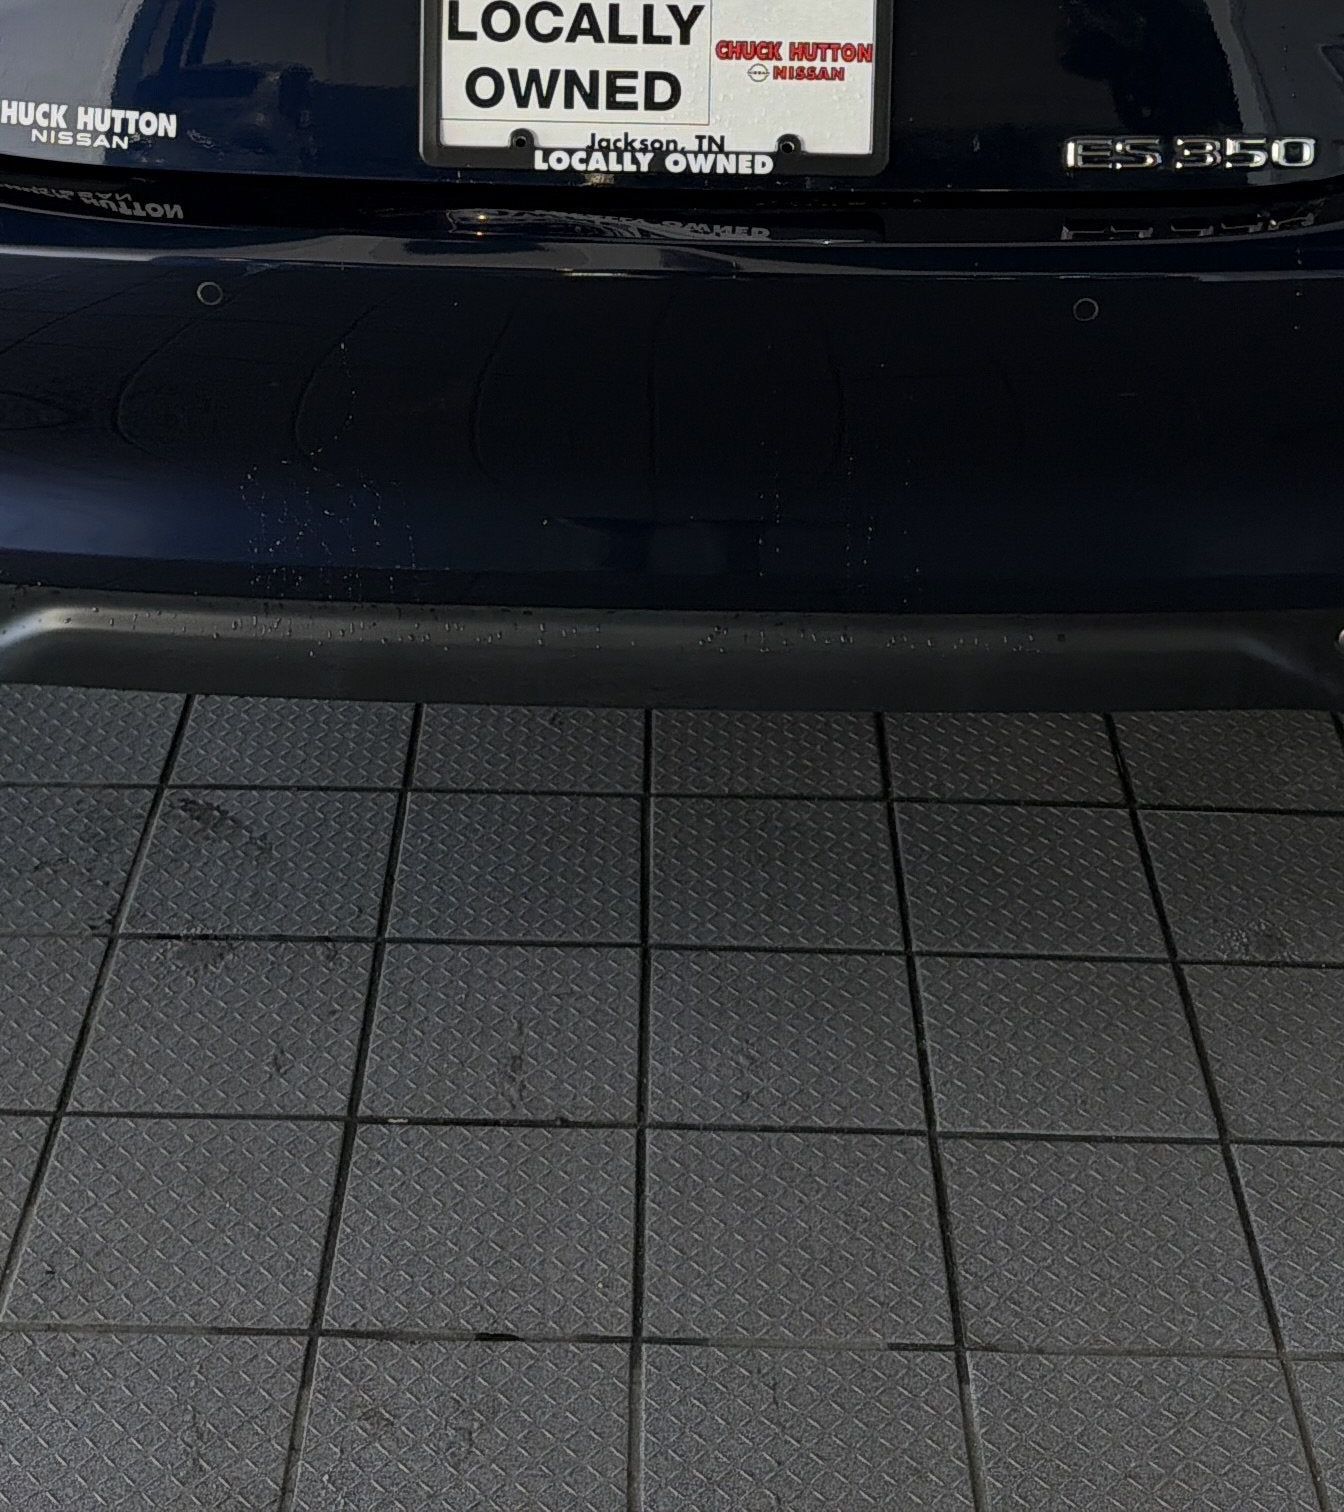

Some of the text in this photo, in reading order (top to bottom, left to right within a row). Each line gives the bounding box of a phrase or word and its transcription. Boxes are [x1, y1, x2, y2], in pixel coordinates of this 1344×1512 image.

[447, 0, 706, 46] LOCALLY
[715, 39, 873, 63] CHUCK HUTTON
[772, 65, 845, 81] NISSAN
[464, 66, 683, 112] OWNED
[76, 106, 177, 138] HUTTON
[30, 128, 129, 150] NISSAN
[586, 131, 725, 152] Jackson, TN
[534, 149, 774, 175] LOCALLY OWNED
[1064, 136, 1316, 170] ES 350
